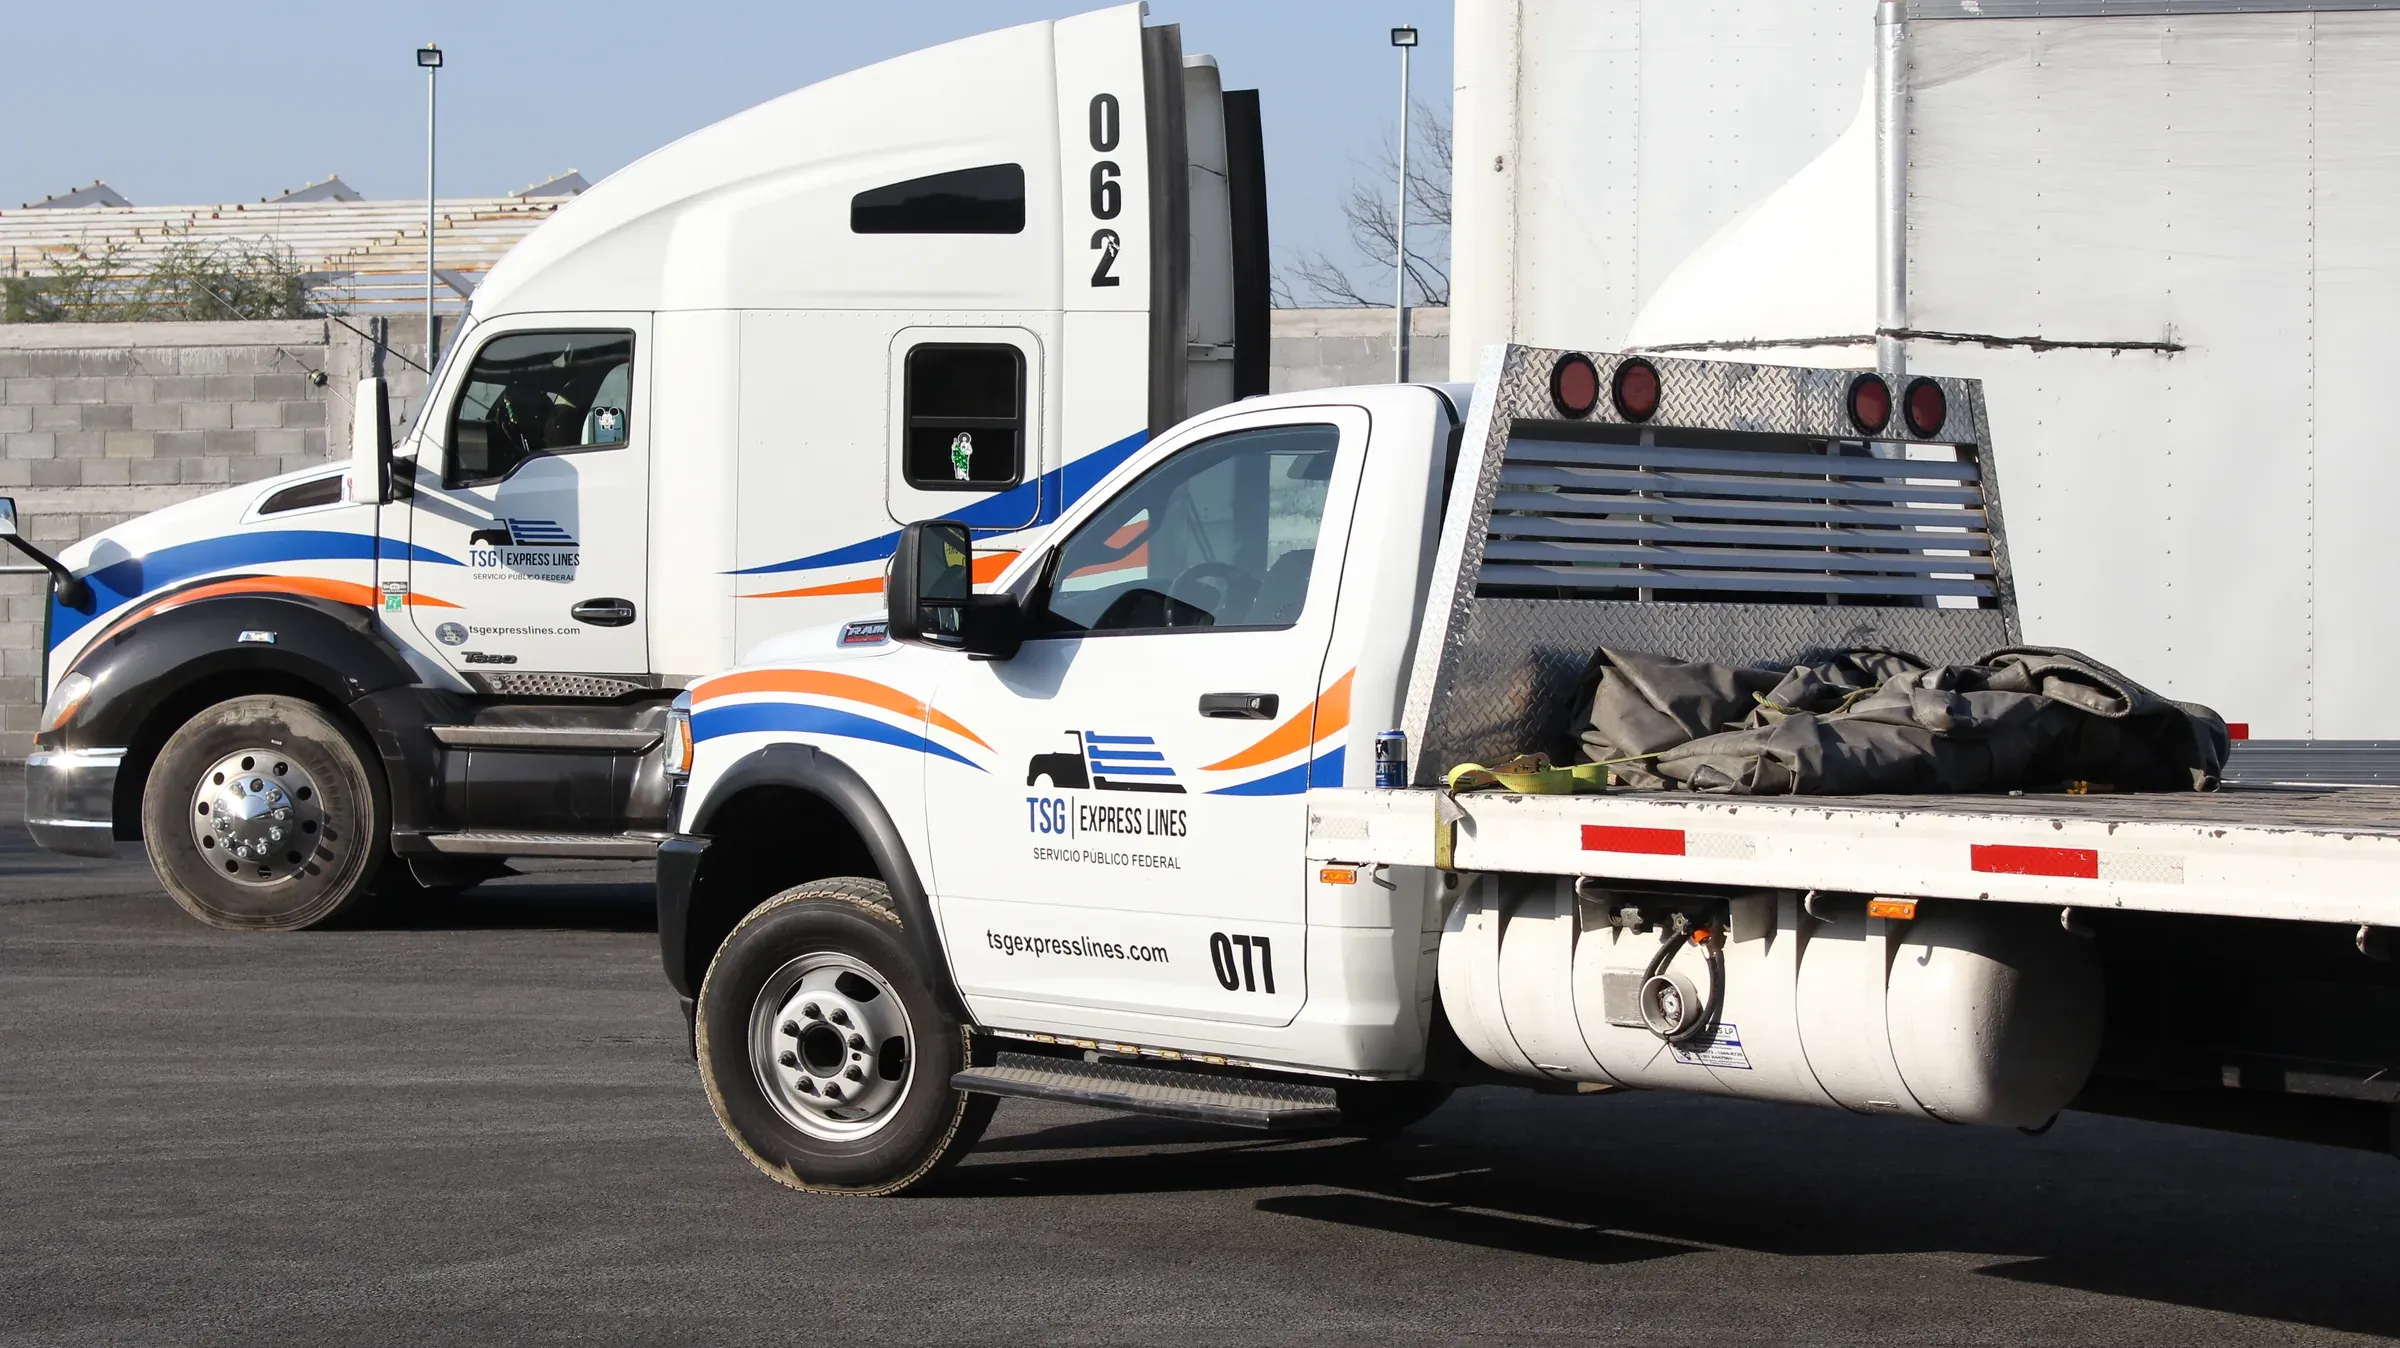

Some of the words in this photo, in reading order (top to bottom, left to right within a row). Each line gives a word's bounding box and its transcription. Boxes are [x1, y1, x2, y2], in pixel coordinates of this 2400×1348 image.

[1089, 93, 1121, 288] 062
[469, 550, 497, 567] TSG
[506, 552, 549, 566] EXPRESS
[552, 553, 580, 566] LINES
[469, 625, 581, 636] tsgexpresslines.com
[847, 625, 887, 636] RAM
[1026, 797, 1066, 834] TSG
[1080, 805, 1142, 835] EXPRESS
[1147, 809, 1187, 837] LINES
[1033, 847, 1081, 862] SERVICIO
[1083, 848, 1129, 866] PÚBLICO
[1132, 854, 1181, 869] FEDERAL
[986, 929, 1169, 963] tsgexpresslines.com
[1209, 931, 1276, 994] 077
